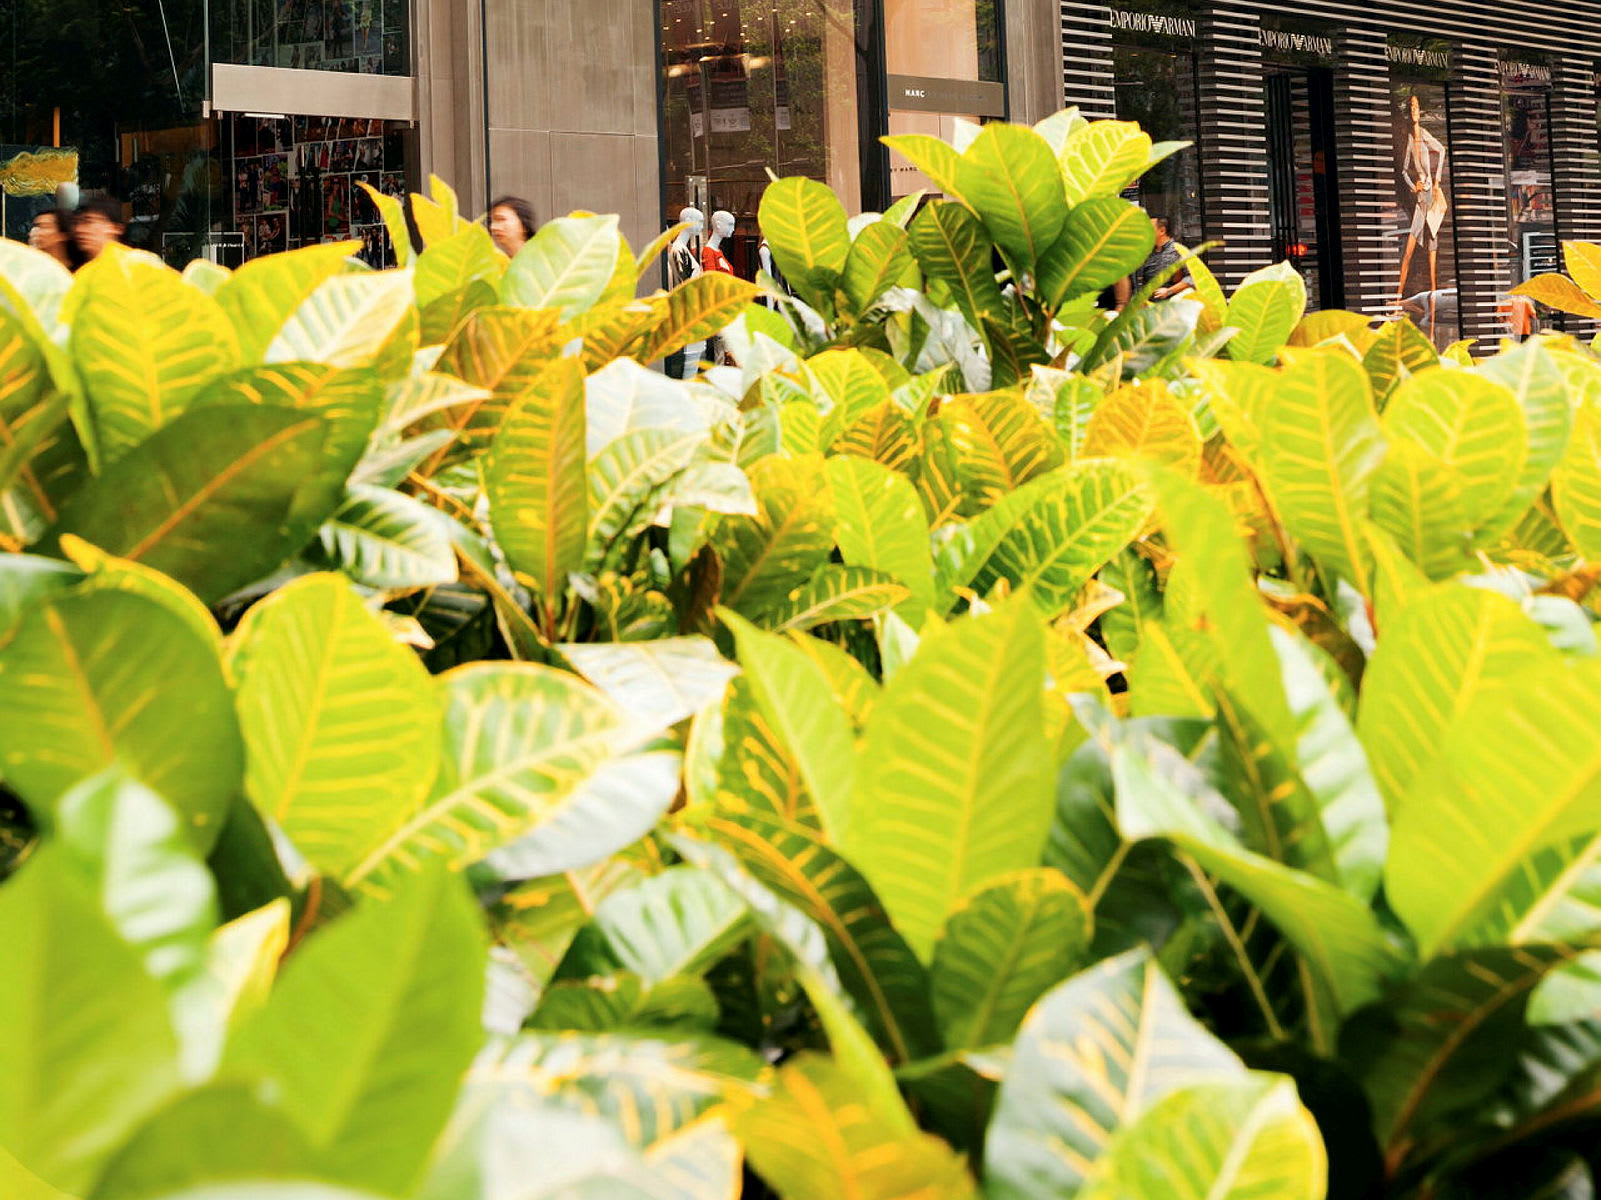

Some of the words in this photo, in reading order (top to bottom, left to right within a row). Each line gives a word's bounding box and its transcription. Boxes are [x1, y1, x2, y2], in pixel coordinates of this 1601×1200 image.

[1110, 10, 1151, 32] EMPORIO
[1162, 16, 1197, 38] ARMANI
[905, 89, 926, 98] MARC
